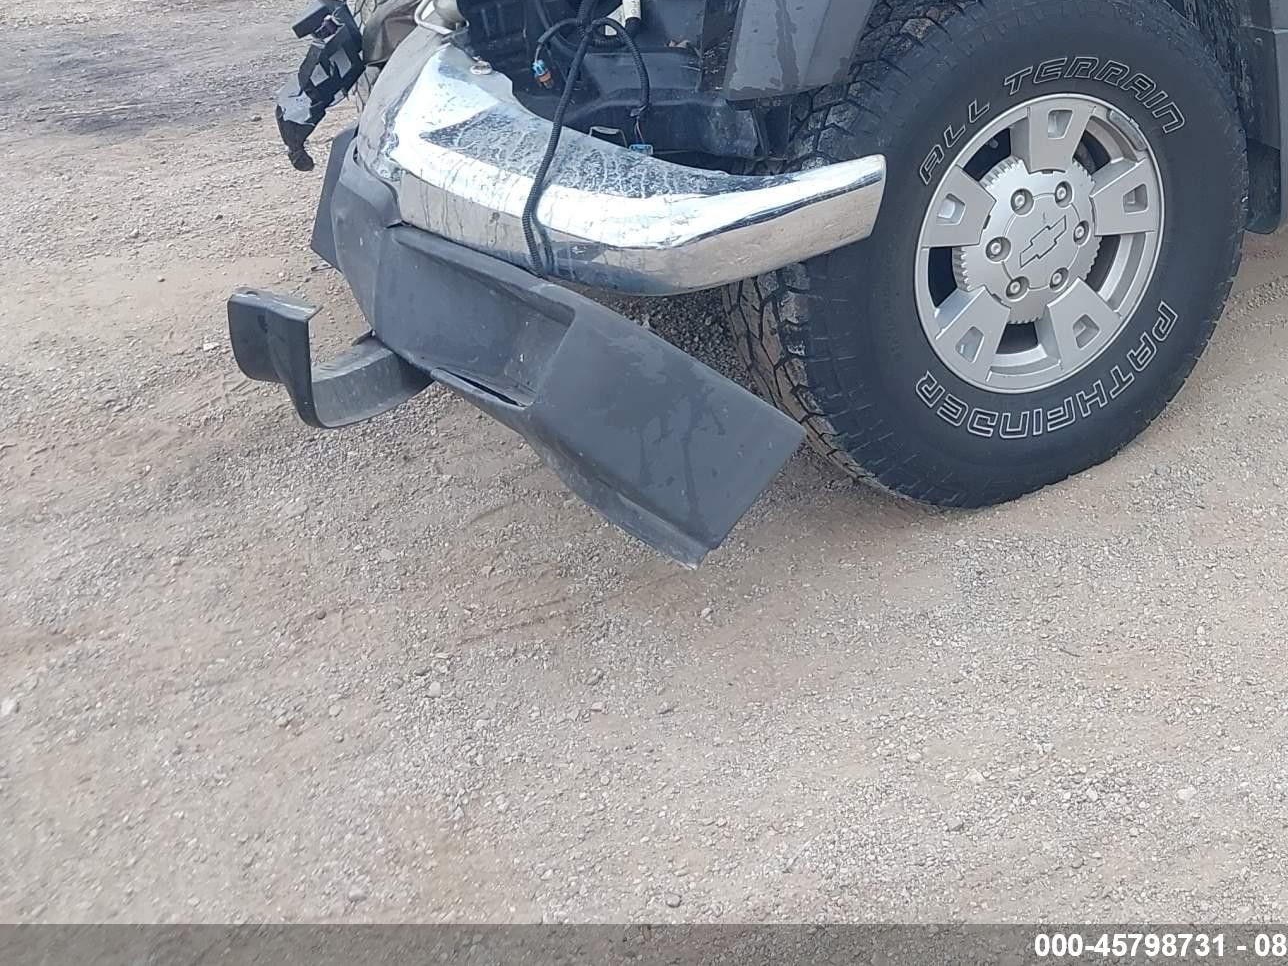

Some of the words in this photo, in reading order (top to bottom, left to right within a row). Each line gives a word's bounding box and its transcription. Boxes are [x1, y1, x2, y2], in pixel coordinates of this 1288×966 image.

[919, 99, 991, 186] ALL
[1003, 56, 1186, 135] TERRAIN
[915, 300, 1179, 439] PATHFINDER
